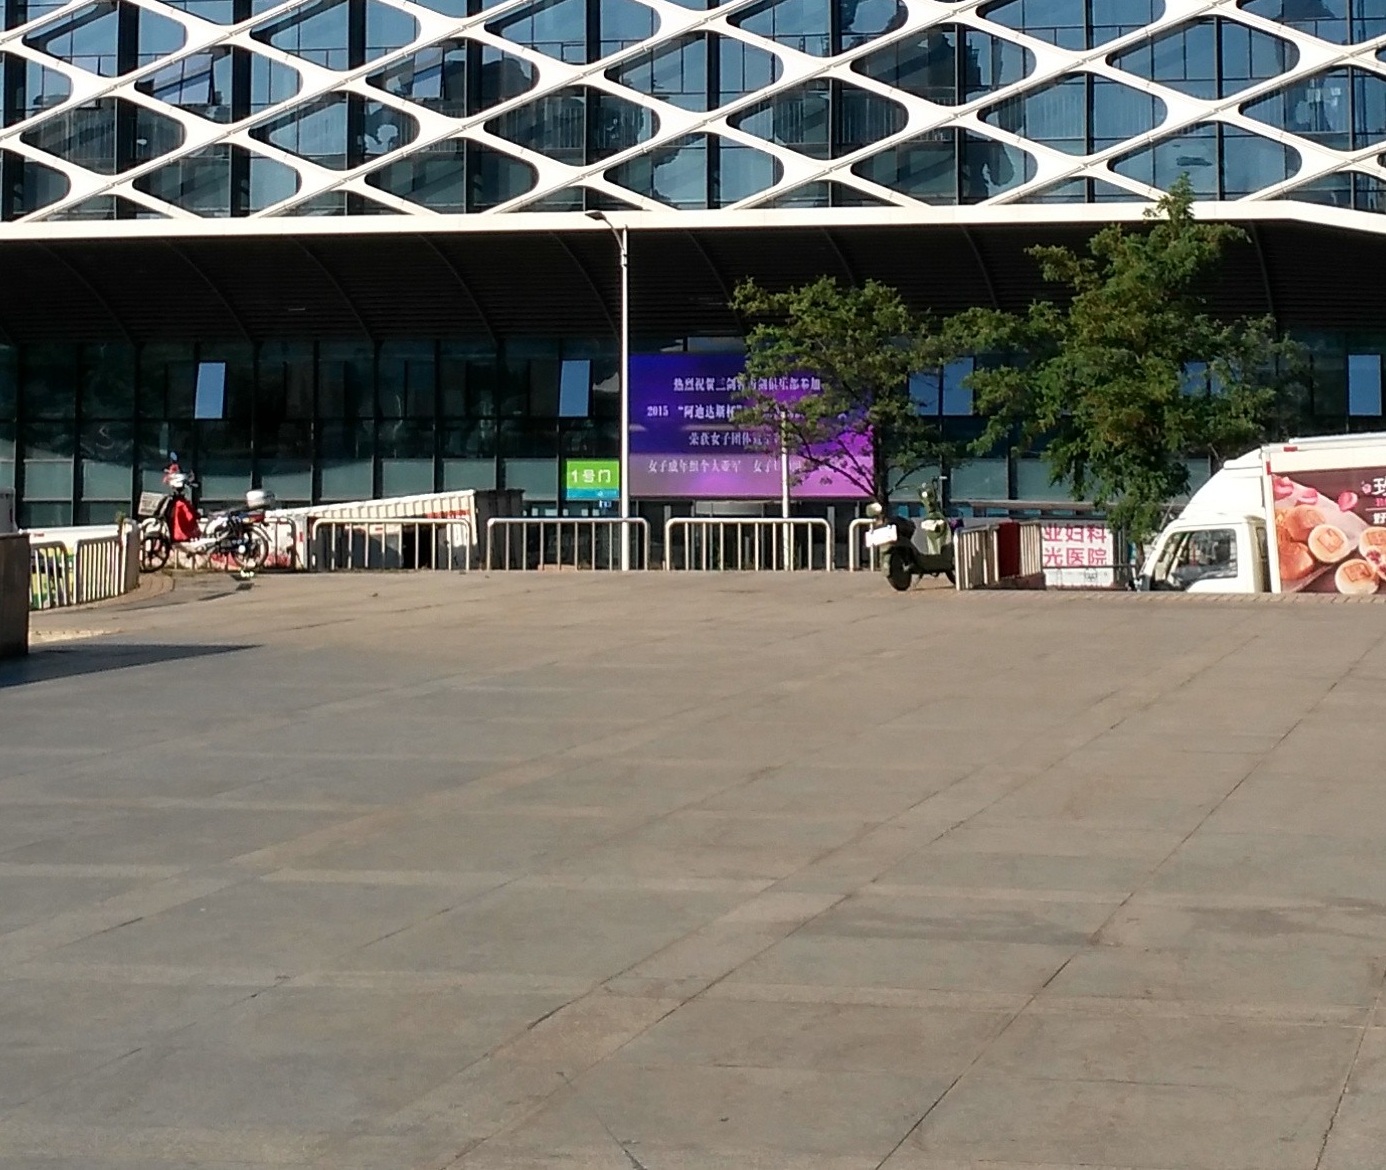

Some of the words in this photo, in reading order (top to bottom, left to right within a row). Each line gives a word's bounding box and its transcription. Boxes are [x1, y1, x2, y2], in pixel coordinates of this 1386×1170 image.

[647, 405, 669, 417] 2015
[571, 468, 611, 483] 1号门
[1044, 546, 1107, 567] 光医院
